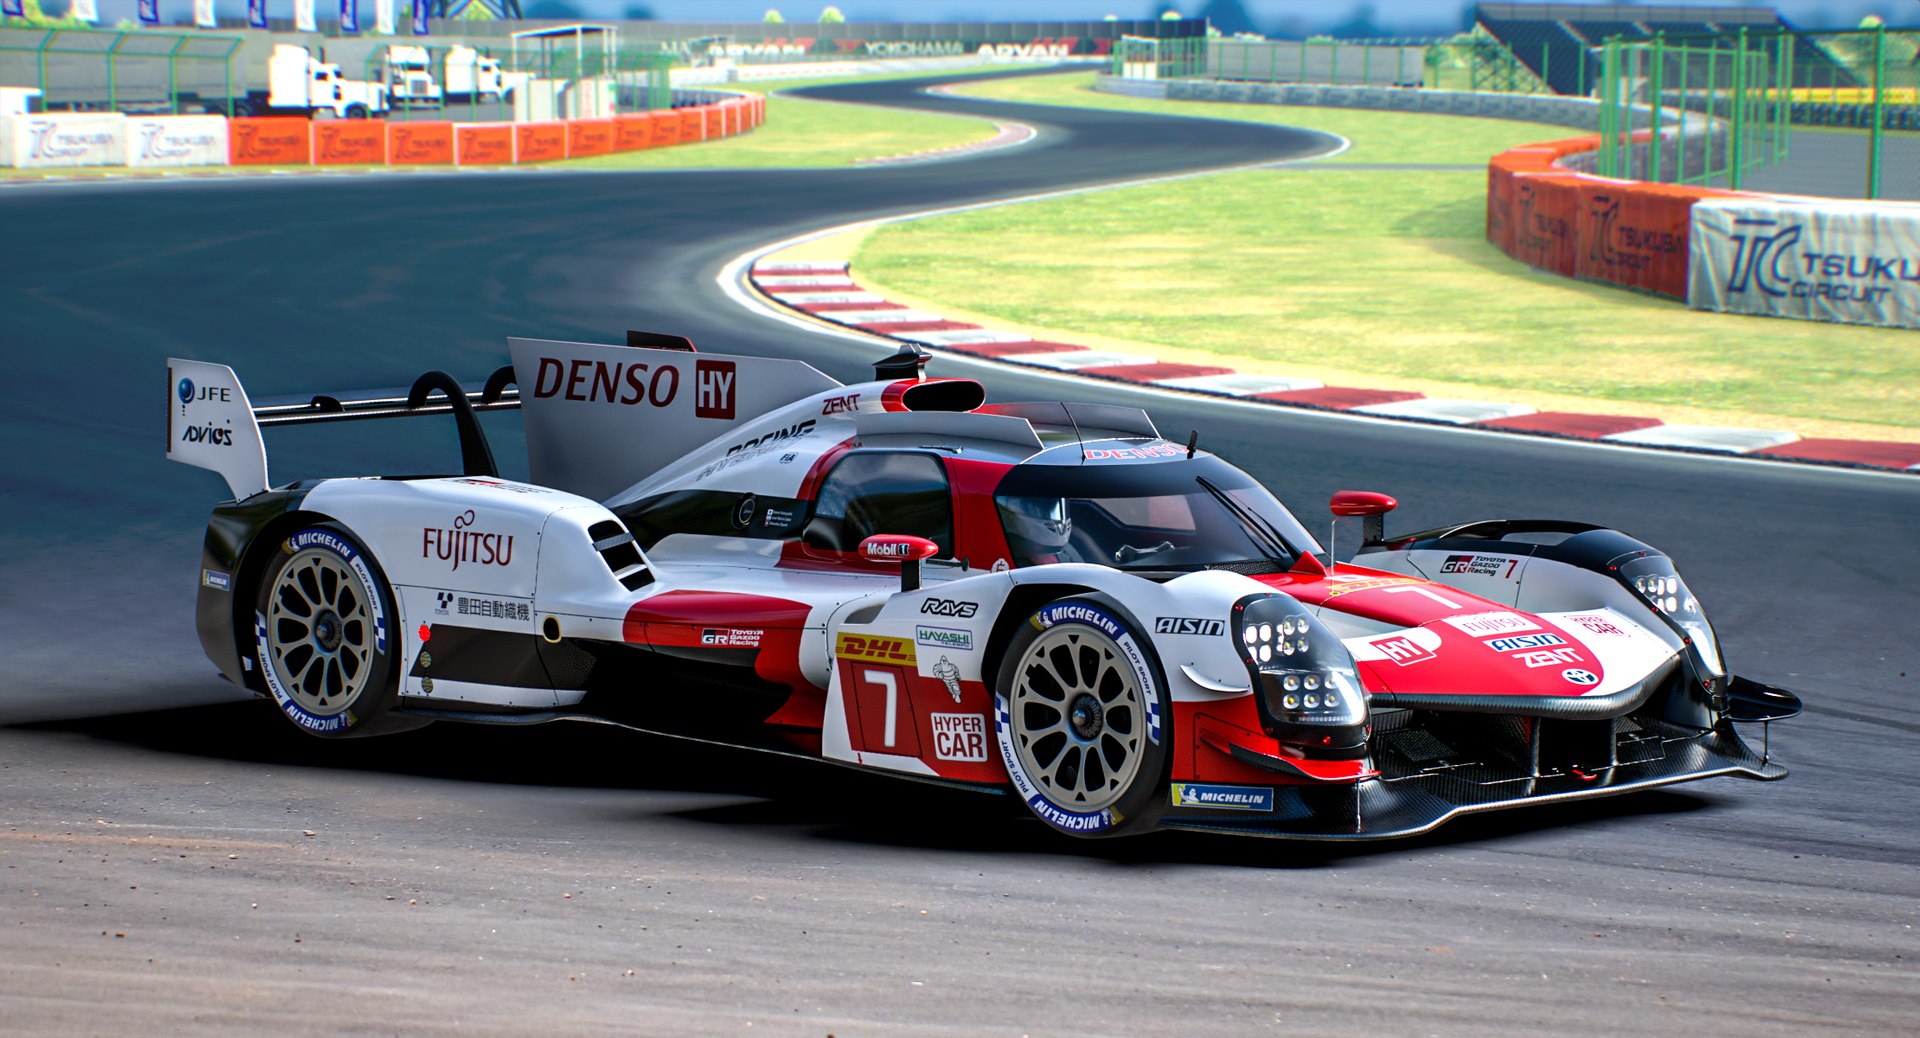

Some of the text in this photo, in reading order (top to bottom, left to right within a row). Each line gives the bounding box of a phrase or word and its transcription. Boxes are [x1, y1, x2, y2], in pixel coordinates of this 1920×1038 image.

[865, 41, 963, 55] YOKOHAMA
[977, 43, 1068, 57] ADVAN
[1618, 226, 1683, 253] TSUKUBA
[1790, 280, 1891, 304] CIRCUIT
[534, 357, 679, 408] DENSO
[698, 369, 735, 410] HY
[197, 386, 231, 402] JFE
[822, 393, 861, 415] ZENT
[780, 453, 797, 464] FIA
[298, 532, 351, 557] MICHELIN
[423, 525, 514, 572] FUJITSU
[867, 543, 897, 556] Mobil
[1441, 560, 1468, 574] GR
[1475, 555, 1507, 563] TOYOTA
[1505, 559, 1518, 579] 7
[1467, 567, 1497, 577] Racing
[355, 563, 378, 611] PILOT SPORT
[1383, 585, 1463, 609] 7
[457, 597, 530, 621] 豊田自動織機
[922, 598, 977, 617] RAYS
[1051, 606, 1119, 635] MICHELIN
[1157, 618, 1225, 635] AISIN
[1462, 616, 1527, 632] FUJITSU
[1582, 623, 1625, 634] CAR
[702, 633, 728, 645] GR
[730, 628, 764, 636] TOYOTA
[919, 629, 969, 642] HAYASHI
[1491, 633, 1564, 651] AISIN
[729, 639, 760, 648] Racing
[842, 636, 908, 661] DHL
[1375, 639, 1423, 661] HY
[1123, 641, 1152, 695] PILOT SPORT
[1511, 647, 1585, 668] ZENT
[260, 652, 283, 700] PILOT SPORT
[286, 704, 339, 731] MICHELIN
[863, 668, 898, 748] 7
[934, 716, 982, 733] HYPER
[937, 731, 984, 758] CAR
[1001, 740, 1030, 794] PILOT SPORT
[1200, 791, 1265, 804] MICHELIN
[1033, 799, 1100, 830] MICHELIN
